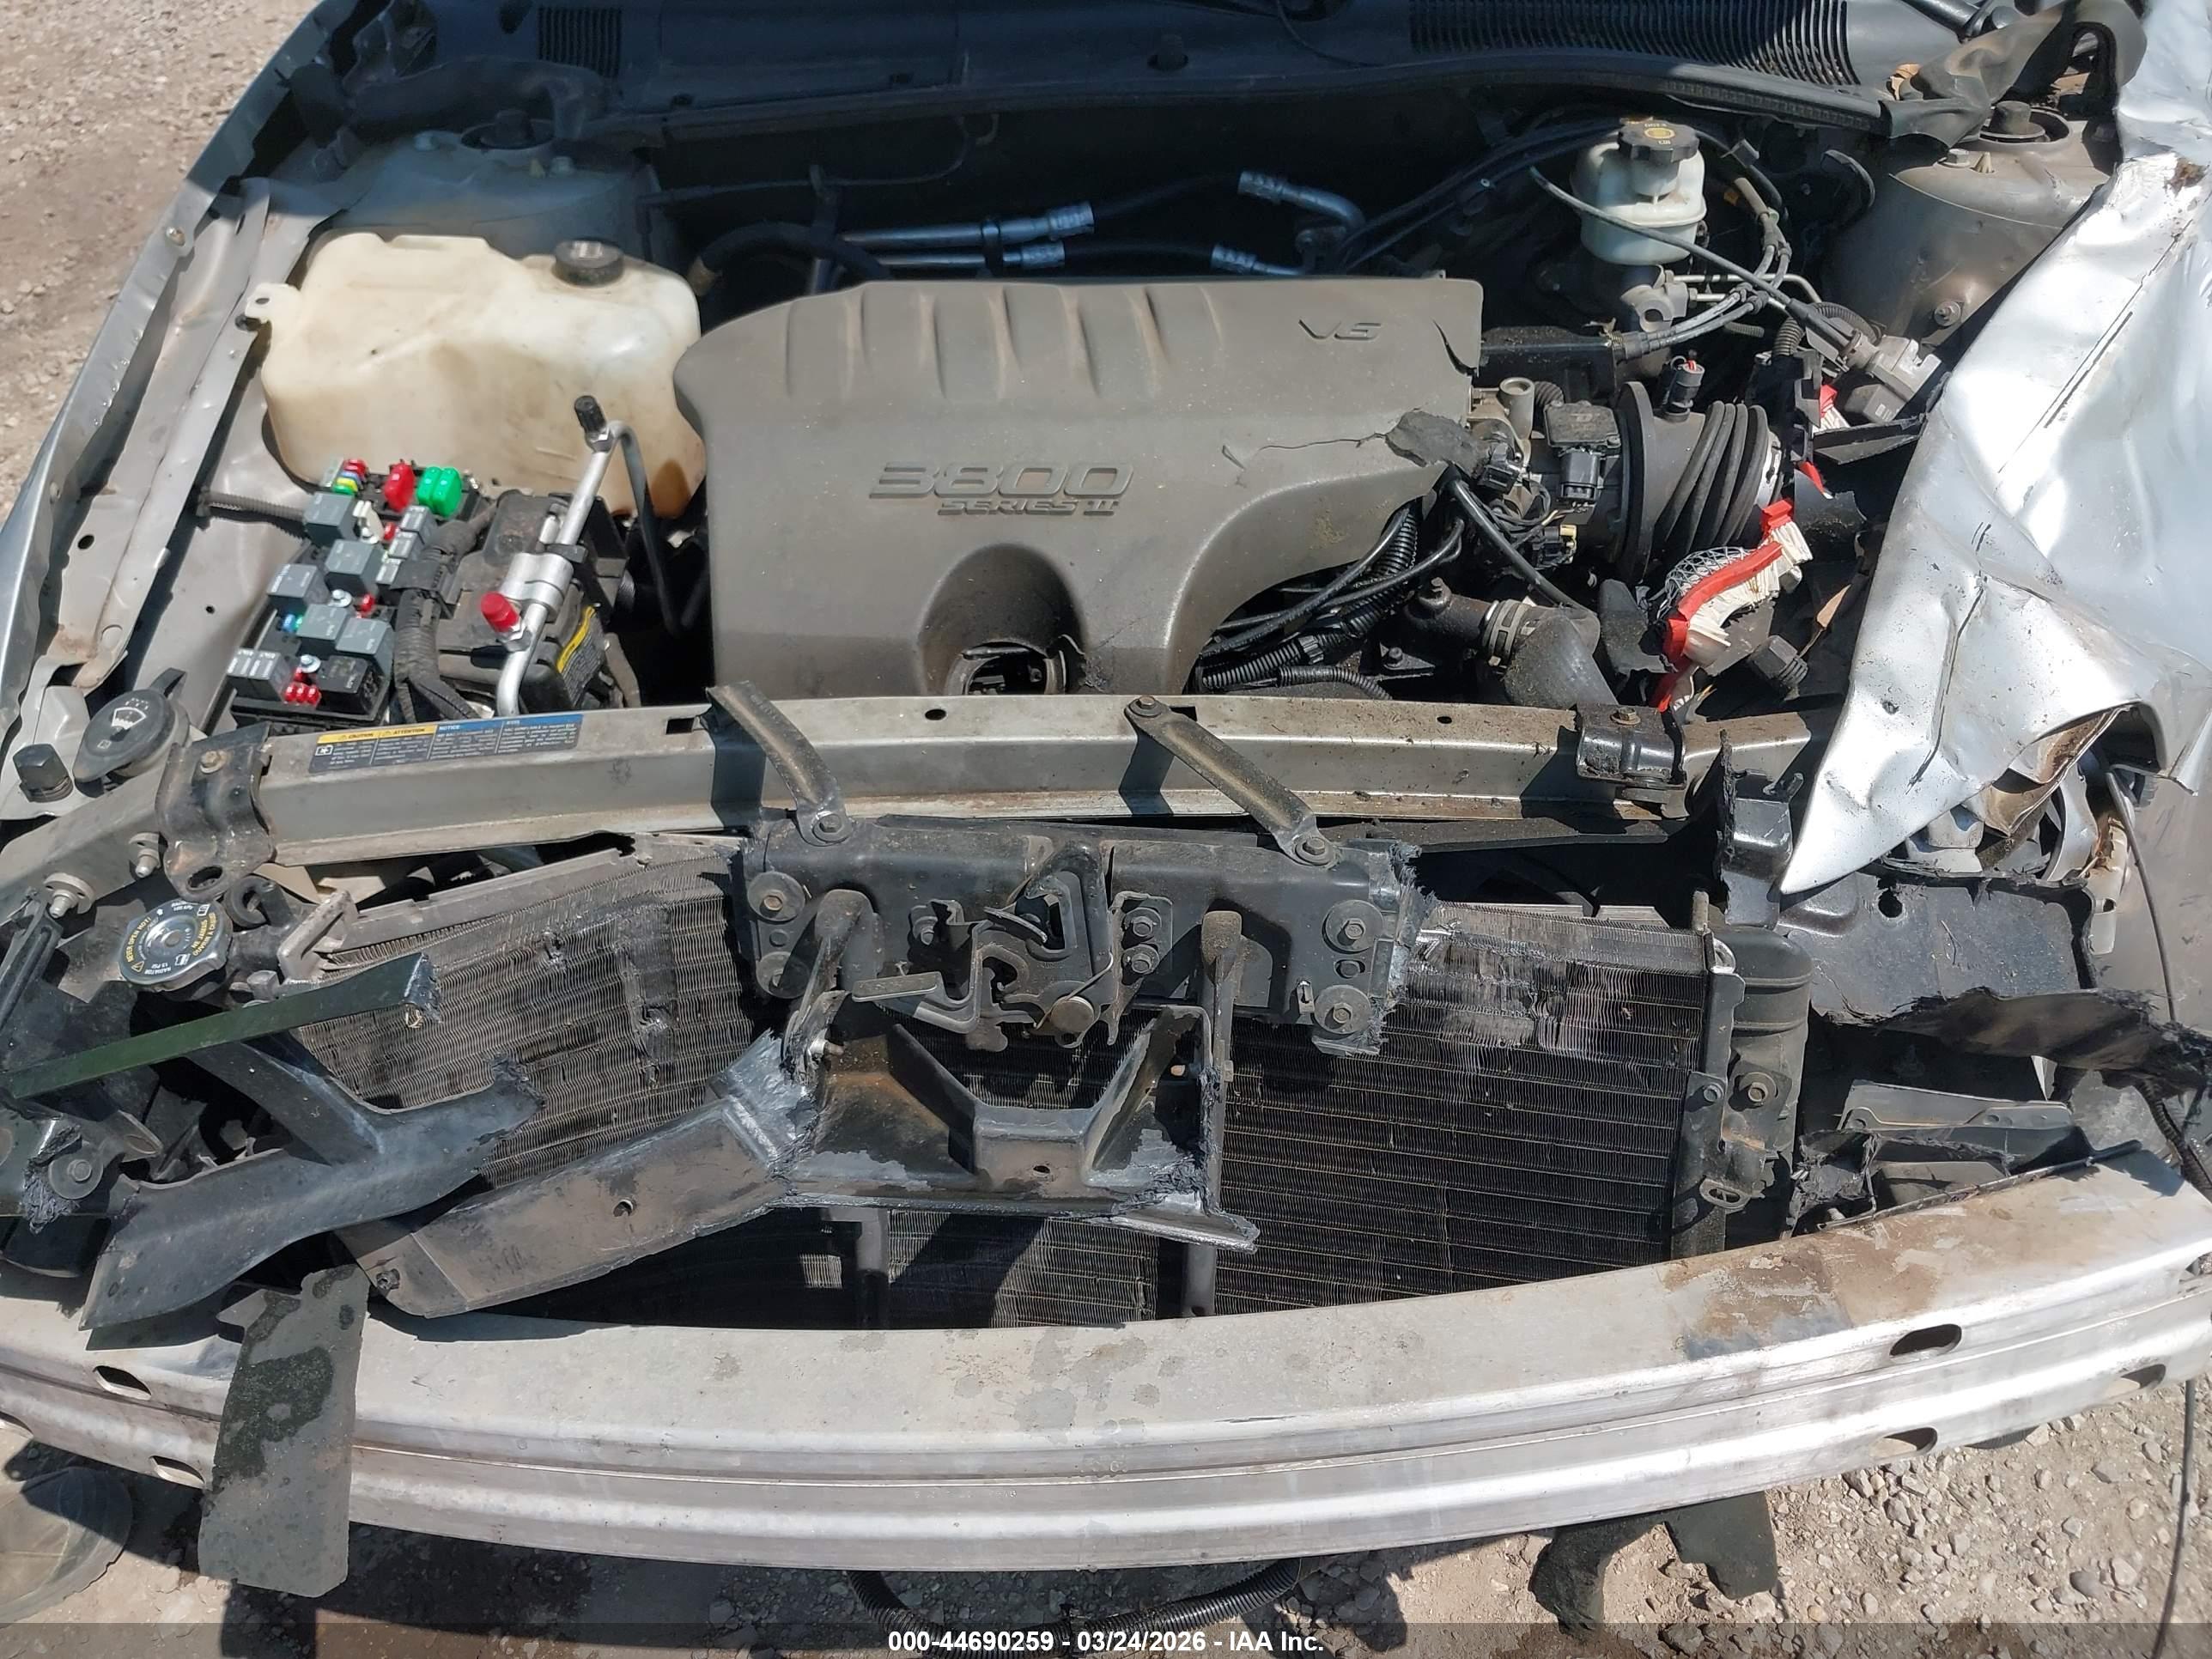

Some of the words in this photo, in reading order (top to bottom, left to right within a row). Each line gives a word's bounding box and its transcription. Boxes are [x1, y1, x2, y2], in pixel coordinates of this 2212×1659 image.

[1297, 318, 1382, 340] V6
[869, 462, 1133, 499] 3800
[937, 497, 1079, 515] SERIES
